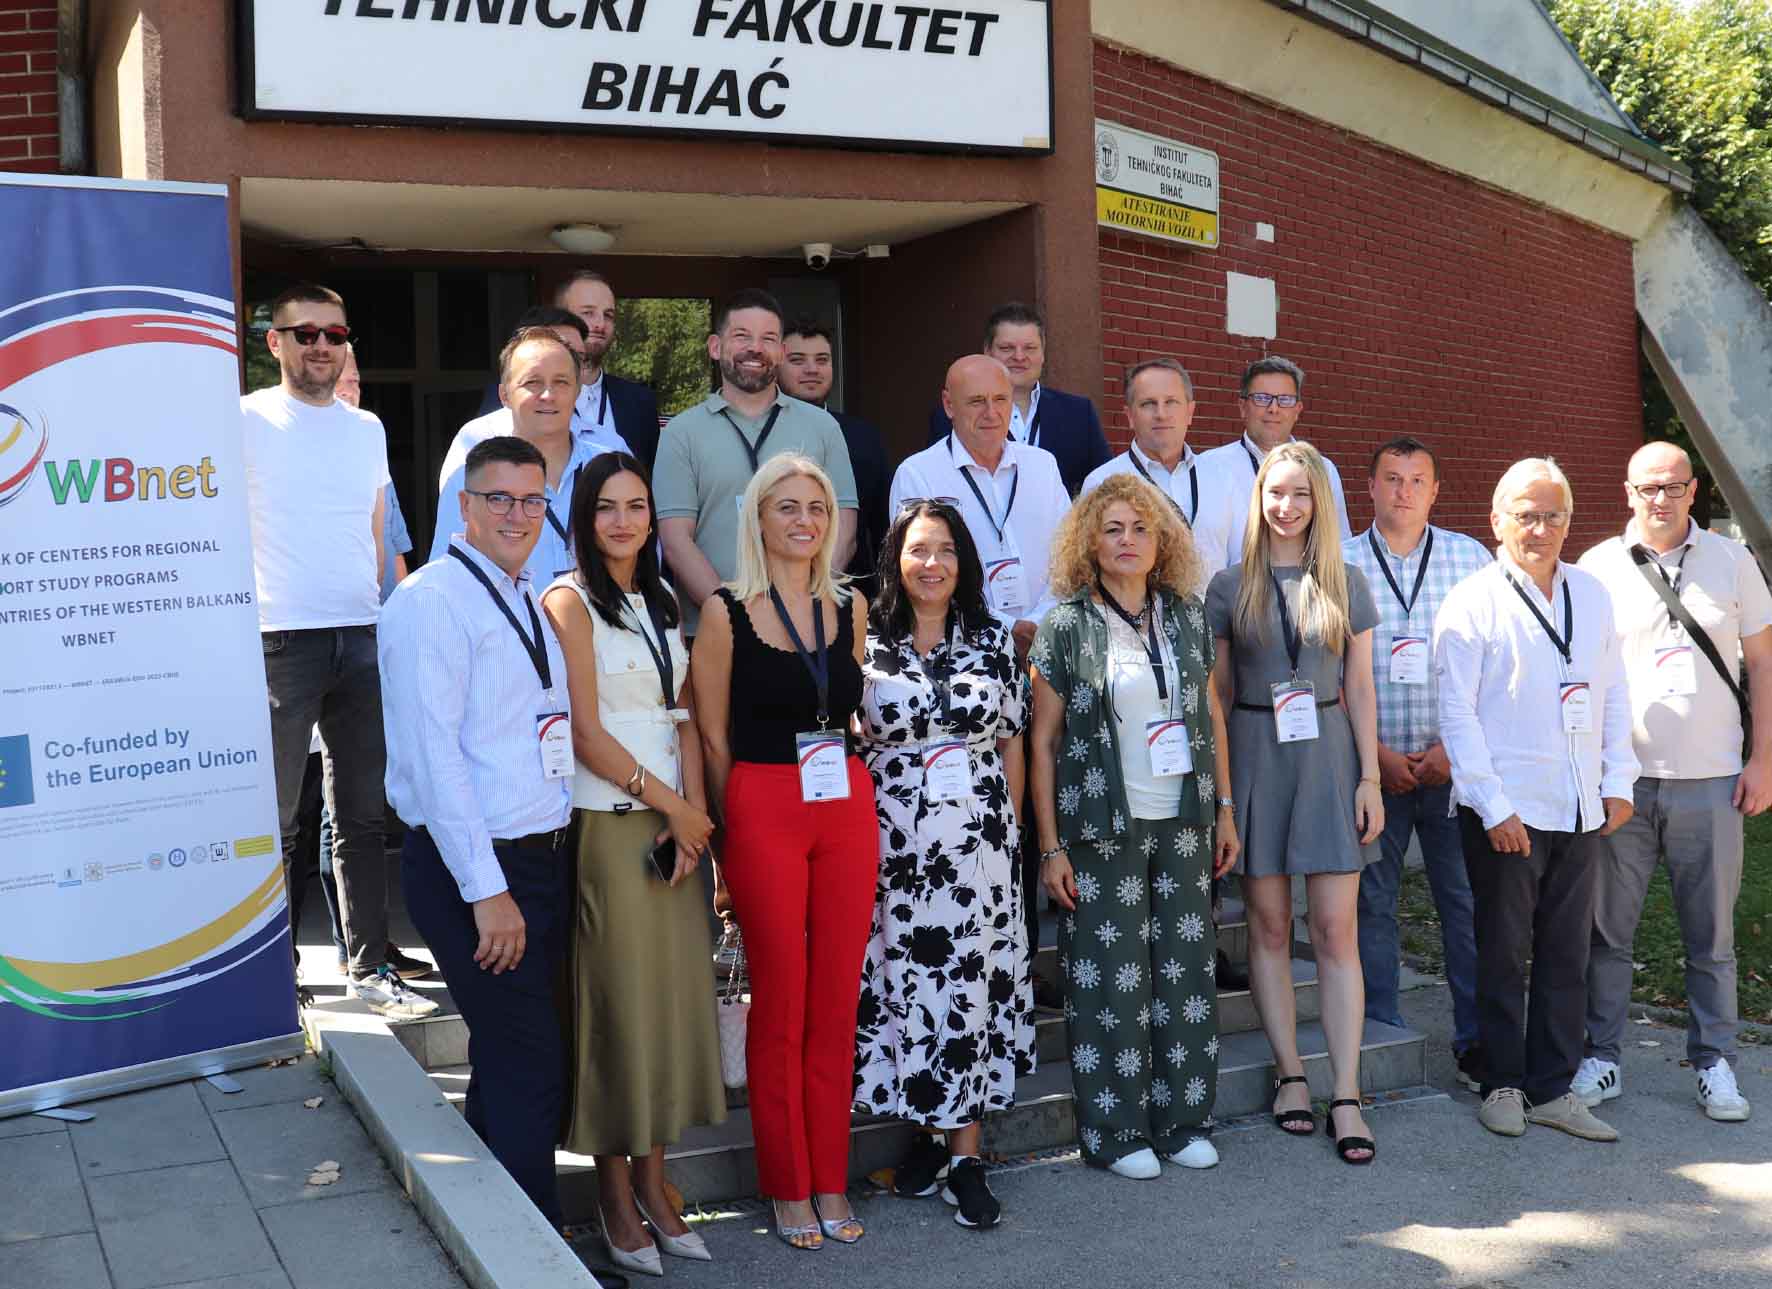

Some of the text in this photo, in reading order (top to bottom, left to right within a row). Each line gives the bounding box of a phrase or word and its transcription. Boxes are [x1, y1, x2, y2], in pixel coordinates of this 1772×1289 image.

[691, 0, 998, 58] FAKULTET
[581, 57, 790, 120] BIHAĆ
[1153, 144, 1188, 164] INSTITUT
[1160, 182, 1183, 199] BIHAĆ
[1173, 167, 1212, 190] FAKULTETA
[1105, 209, 1165, 233] MOTORNIH
[1120, 196, 1191, 223] ATESTIRANJE
[44, 456, 218, 505] WBnet
[15, 551, 35, 565] OF
[40, 546, 108, 563] CENTERS
[112, 544, 142, 558] FOR
[146, 540, 221, 555] REGIONAL
[39, 576, 90, 592] STUDY
[95, 570, 179, 588] PROGRAMS
[56, 606, 76, 619] OF
[80, 603, 110, 617] THE
[112, 598, 183, 615] WESTERN
[187, 592, 252, 609] BALKANS
[61, 631, 117, 648] WBNET
[44, 728, 190, 760] Co-funded by
[46, 748, 257, 789] the European Union
